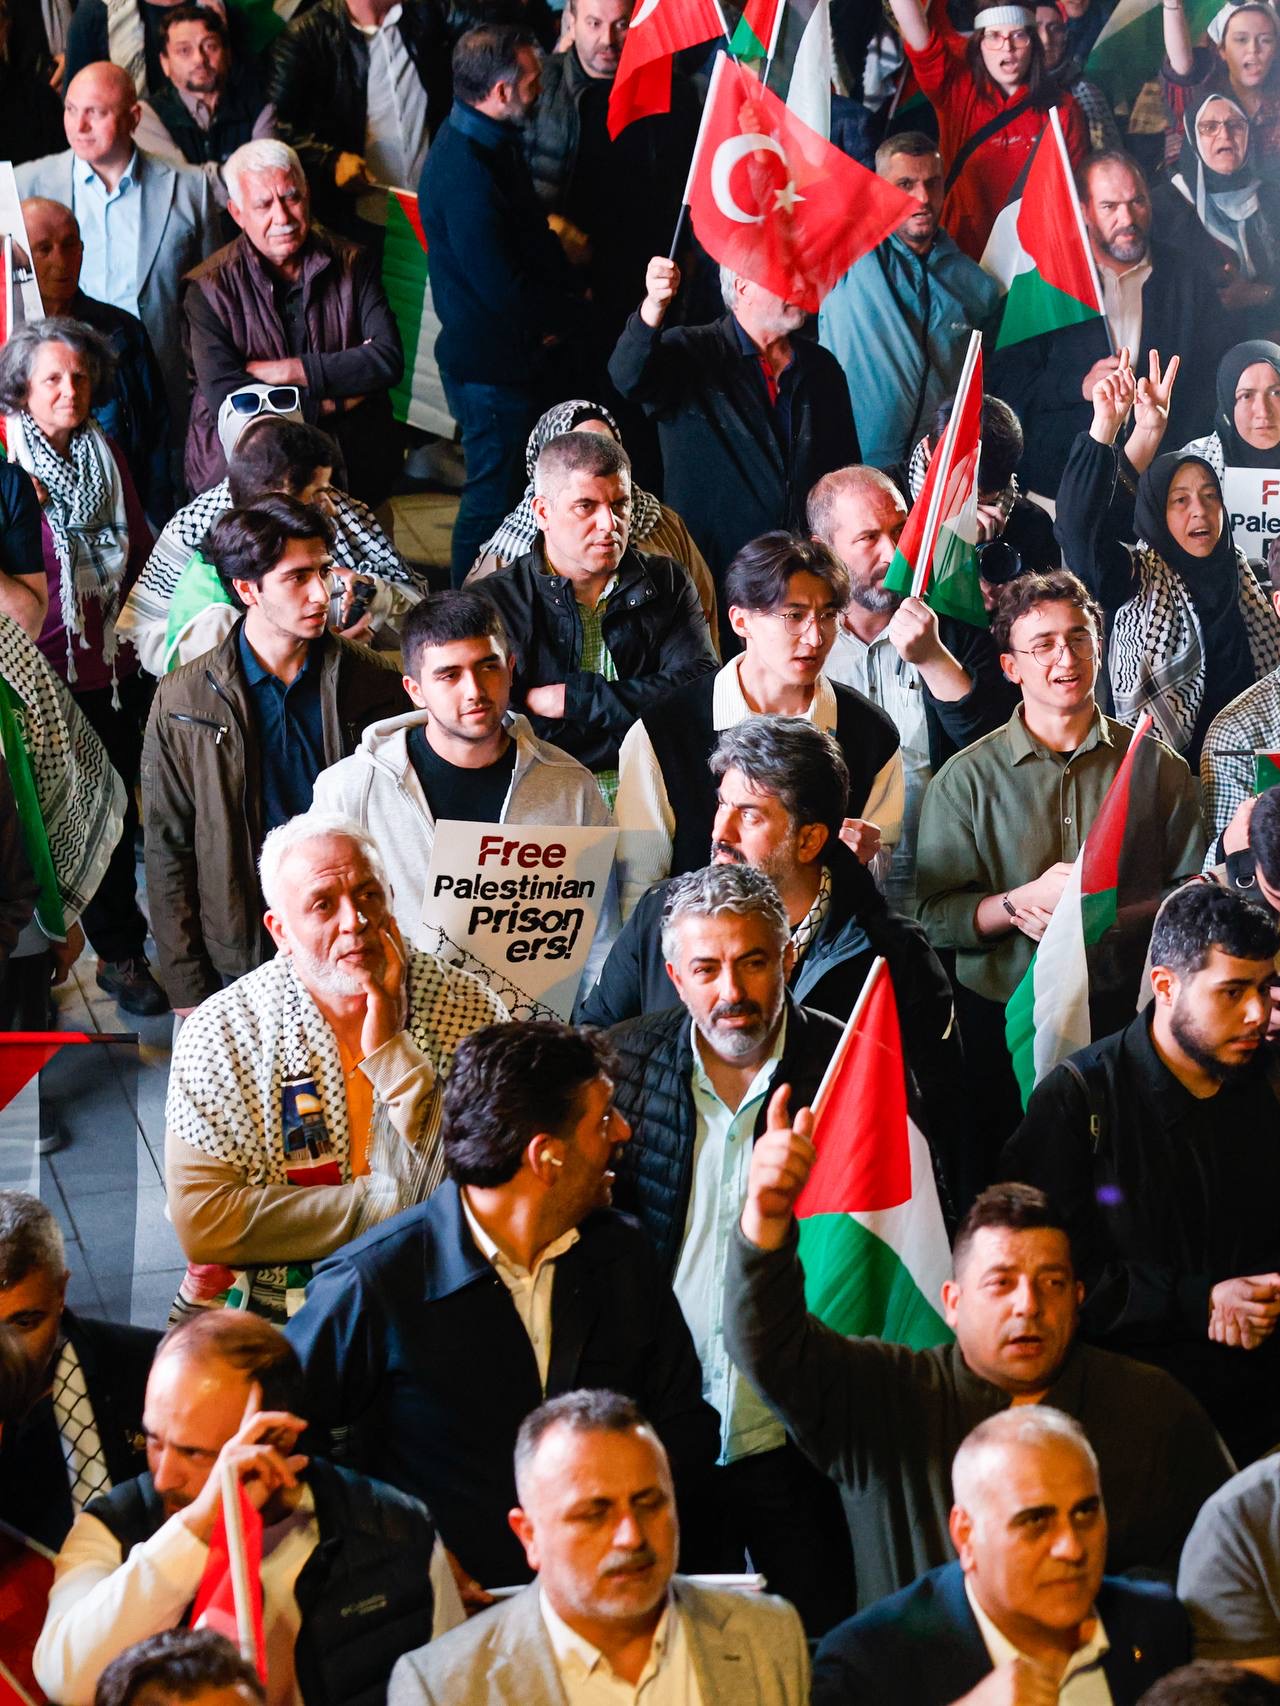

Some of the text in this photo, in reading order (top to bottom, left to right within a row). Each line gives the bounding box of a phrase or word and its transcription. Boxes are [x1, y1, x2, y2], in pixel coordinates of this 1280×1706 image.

[478, 835, 567, 868] Free
[433, 873, 596, 901] Palestinian
[467, 901, 585, 936] Prison
[506, 928, 579, 963] ers!
